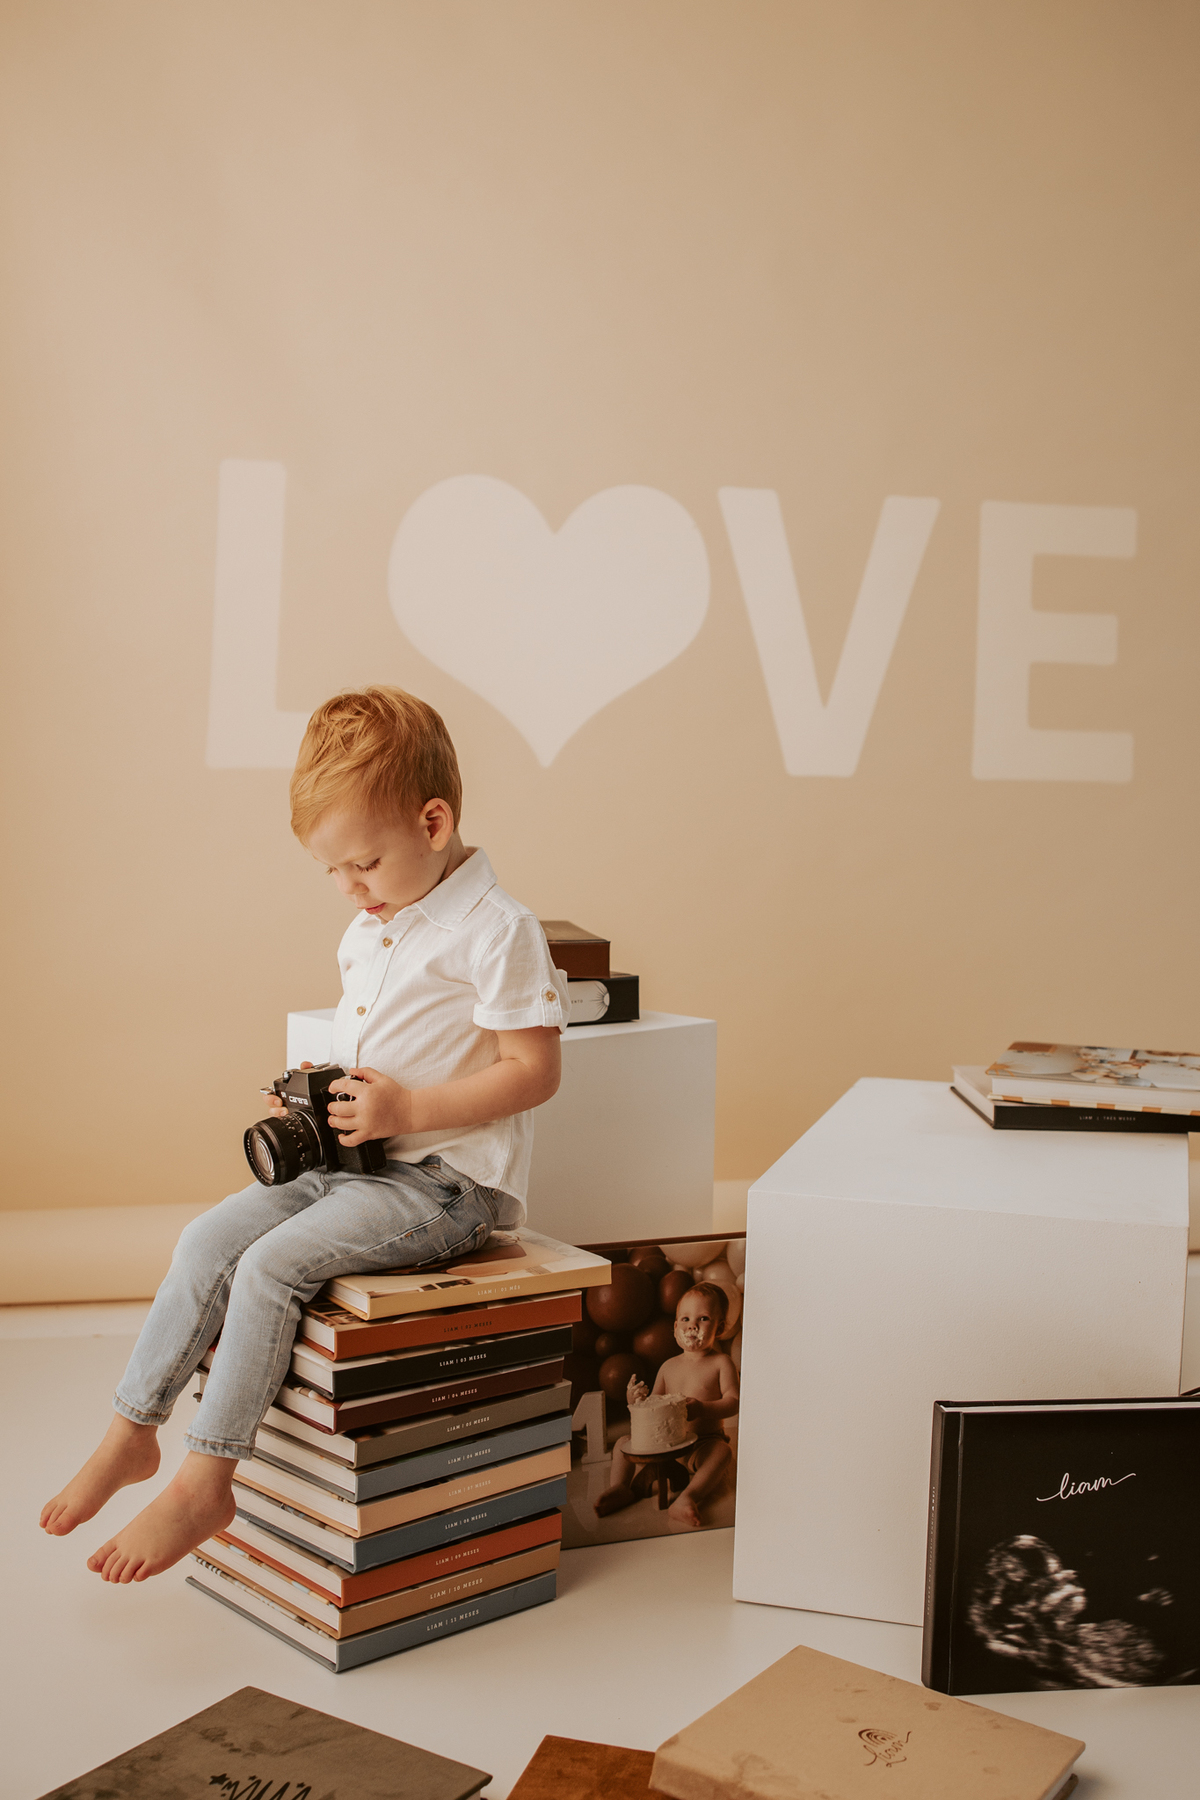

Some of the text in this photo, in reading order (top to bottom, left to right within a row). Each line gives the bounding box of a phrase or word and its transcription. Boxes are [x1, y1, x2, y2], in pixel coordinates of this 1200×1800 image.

[439, 1359, 454, 1367] LIAM
[468, 1353, 487, 1361] MESES
[431, 1395, 446, 1403] LIAM
[460, 1388, 478, 1396] MESES
[446, 1424, 460, 1432] LIAM
[473, 1416, 490, 1425] MESES
[447, 1456, 461, 1465] LIAM
[474, 1448, 491, 1457] MESES
[448, 1489, 462, 1497] LIAM
[474, 1479, 491, 1488] MESES
[444, 1521, 458, 1530] LIAM
[470, 1512, 488, 1521] MESES
[435, 1557, 449, 1566] LIAM
[462, 1548, 480, 1557] MESES
[429, 1589, 446, 1600] LIAM
[462, 1577, 483, 1589] MESES
[426, 1621, 443, 1632] LIAM
[450, 1616, 457, 1624] 11
[459, 1608, 480, 1621] MESES
